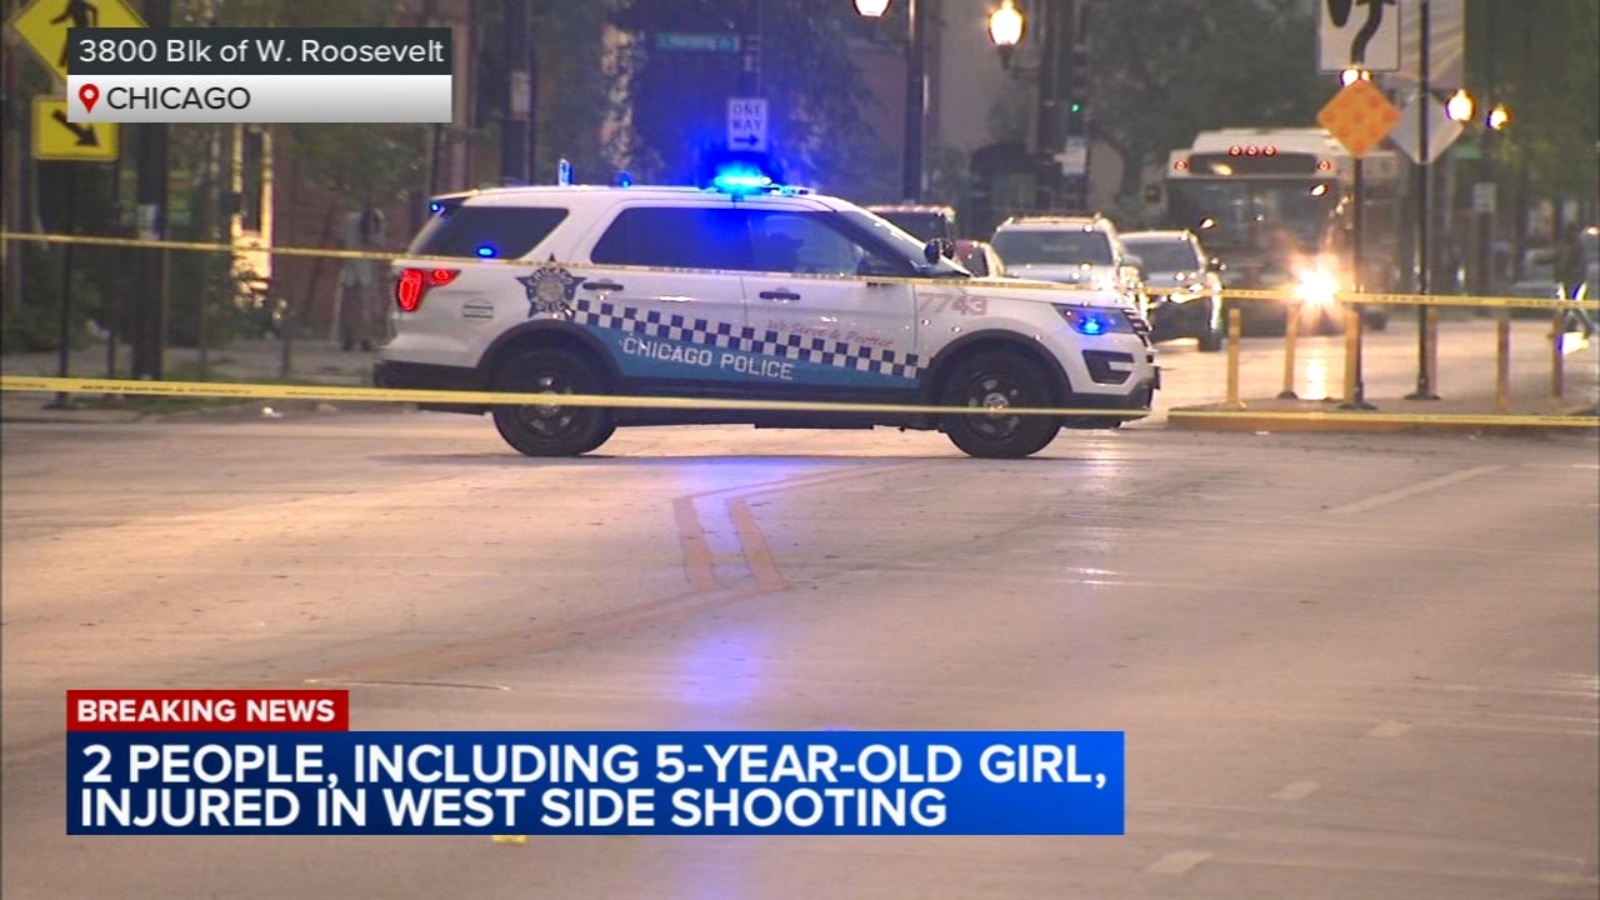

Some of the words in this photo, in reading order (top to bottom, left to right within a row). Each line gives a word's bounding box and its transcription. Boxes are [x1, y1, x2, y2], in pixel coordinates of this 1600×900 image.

[733, 105, 761, 115] ONE
[732, 120, 762, 131] WAY
[919, 292, 987, 315] 7743
[623, 337, 713, 367] CHICAGO
[720, 353, 795, 381] POLICE
